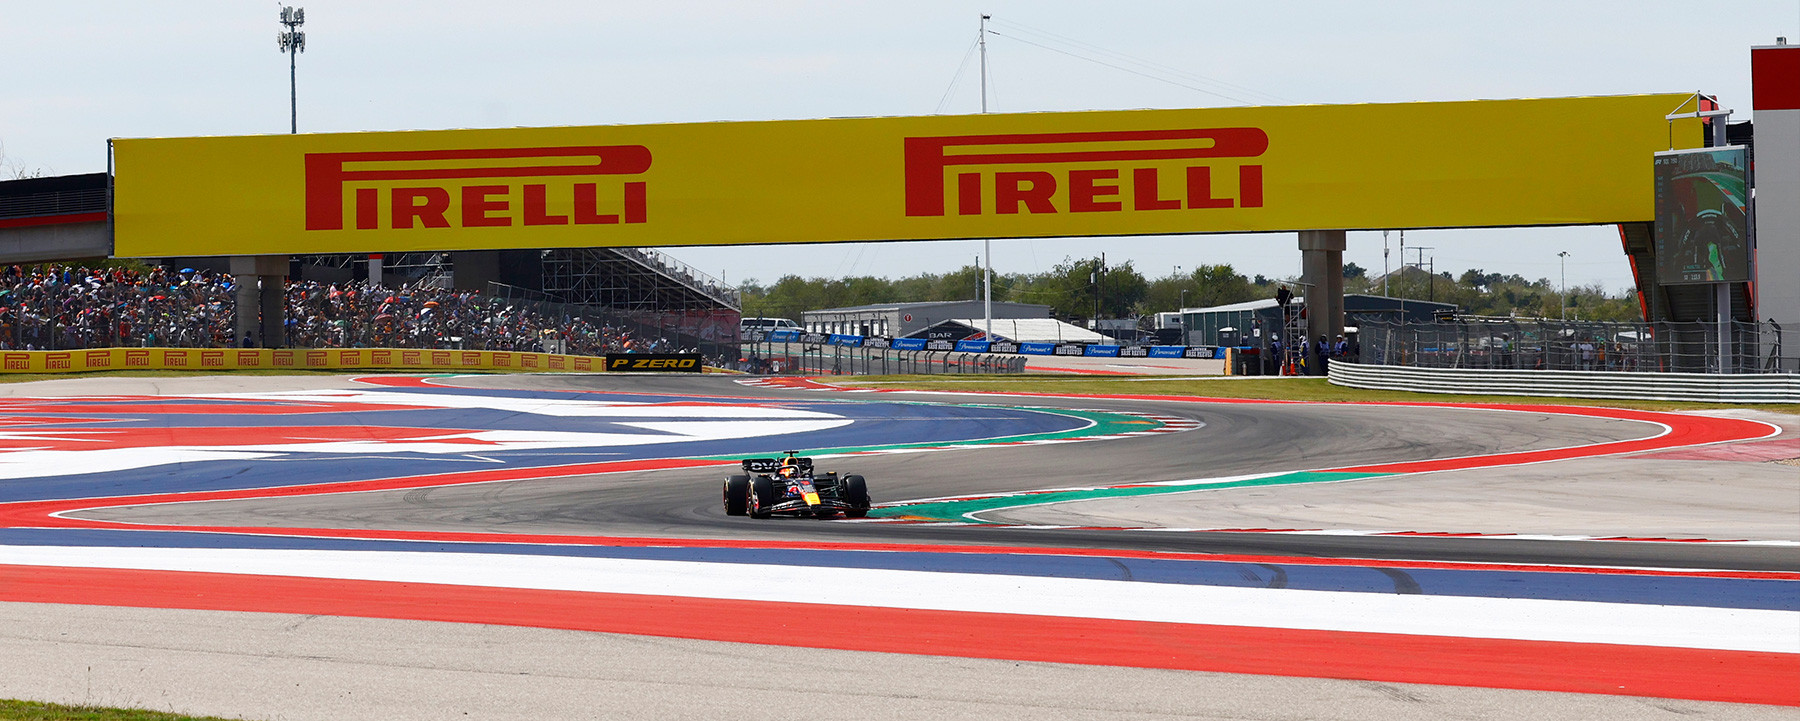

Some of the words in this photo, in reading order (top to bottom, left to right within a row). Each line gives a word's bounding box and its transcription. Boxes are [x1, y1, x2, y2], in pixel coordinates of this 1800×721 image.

[904, 127, 1269, 216] PIRELLI
[304, 145, 652, 230] PIRELLI
[4, 353, 30, 369] PIRELLI
[45, 353, 71, 369] PIRELLI
[86, 351, 110, 367] PIRELLI
[126, 350, 149, 366] PIRELLI
[164, 351, 187, 366] PIRELLI
[201, 351, 224, 366] PIRELLI
[238, 351, 259, 366] PIRELLI
[272, 351, 294, 366] PIRELLI
[306, 351, 327, 366] PIRELLI
[340, 351, 360, 365] PIRELLI
[372, 351, 391, 365] PIRELLI
[402, 351, 421, 365] PIRELLI
[432, 352, 451, 365] PIRELLI
[462, 352, 481, 366] PIRELLI
[493, 353, 511, 366] PIRELLI
[612, 359, 629, 368] P
[632, 359, 696, 368] ZERO
